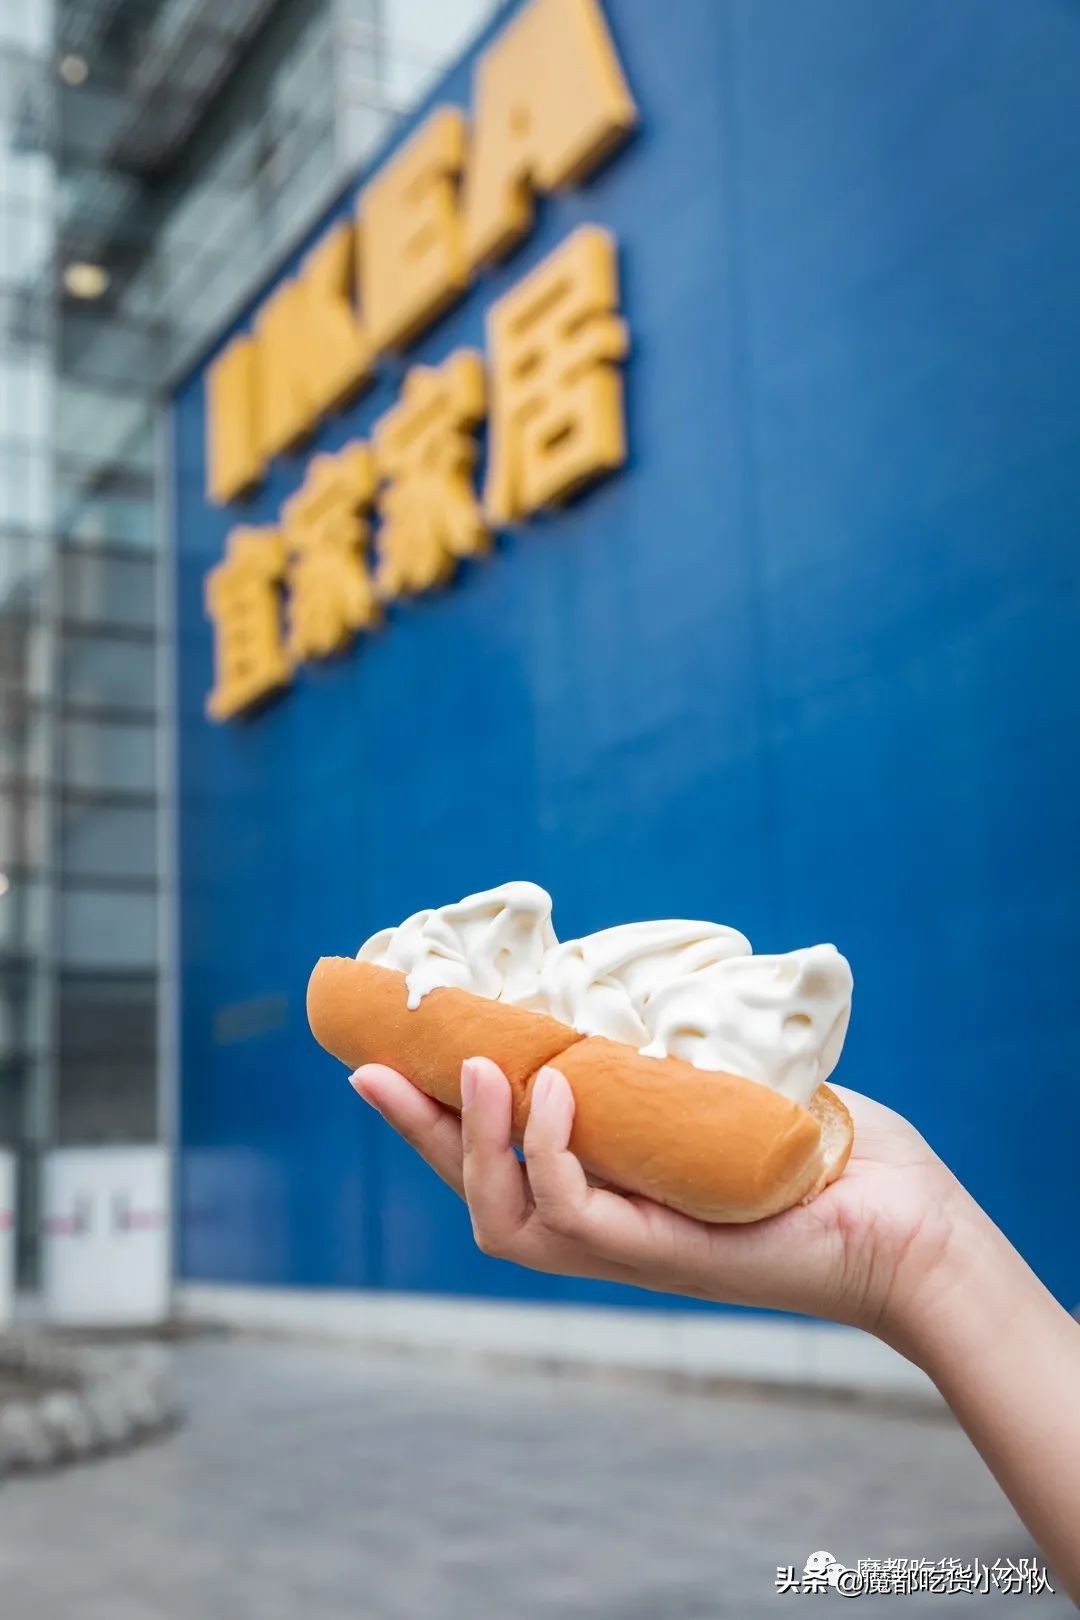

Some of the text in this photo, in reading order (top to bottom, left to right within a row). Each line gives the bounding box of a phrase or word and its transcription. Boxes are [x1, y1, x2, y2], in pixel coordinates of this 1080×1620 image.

[206, 223, 629, 722] 宜家家居
[207, 0, 637, 507] IKEA
